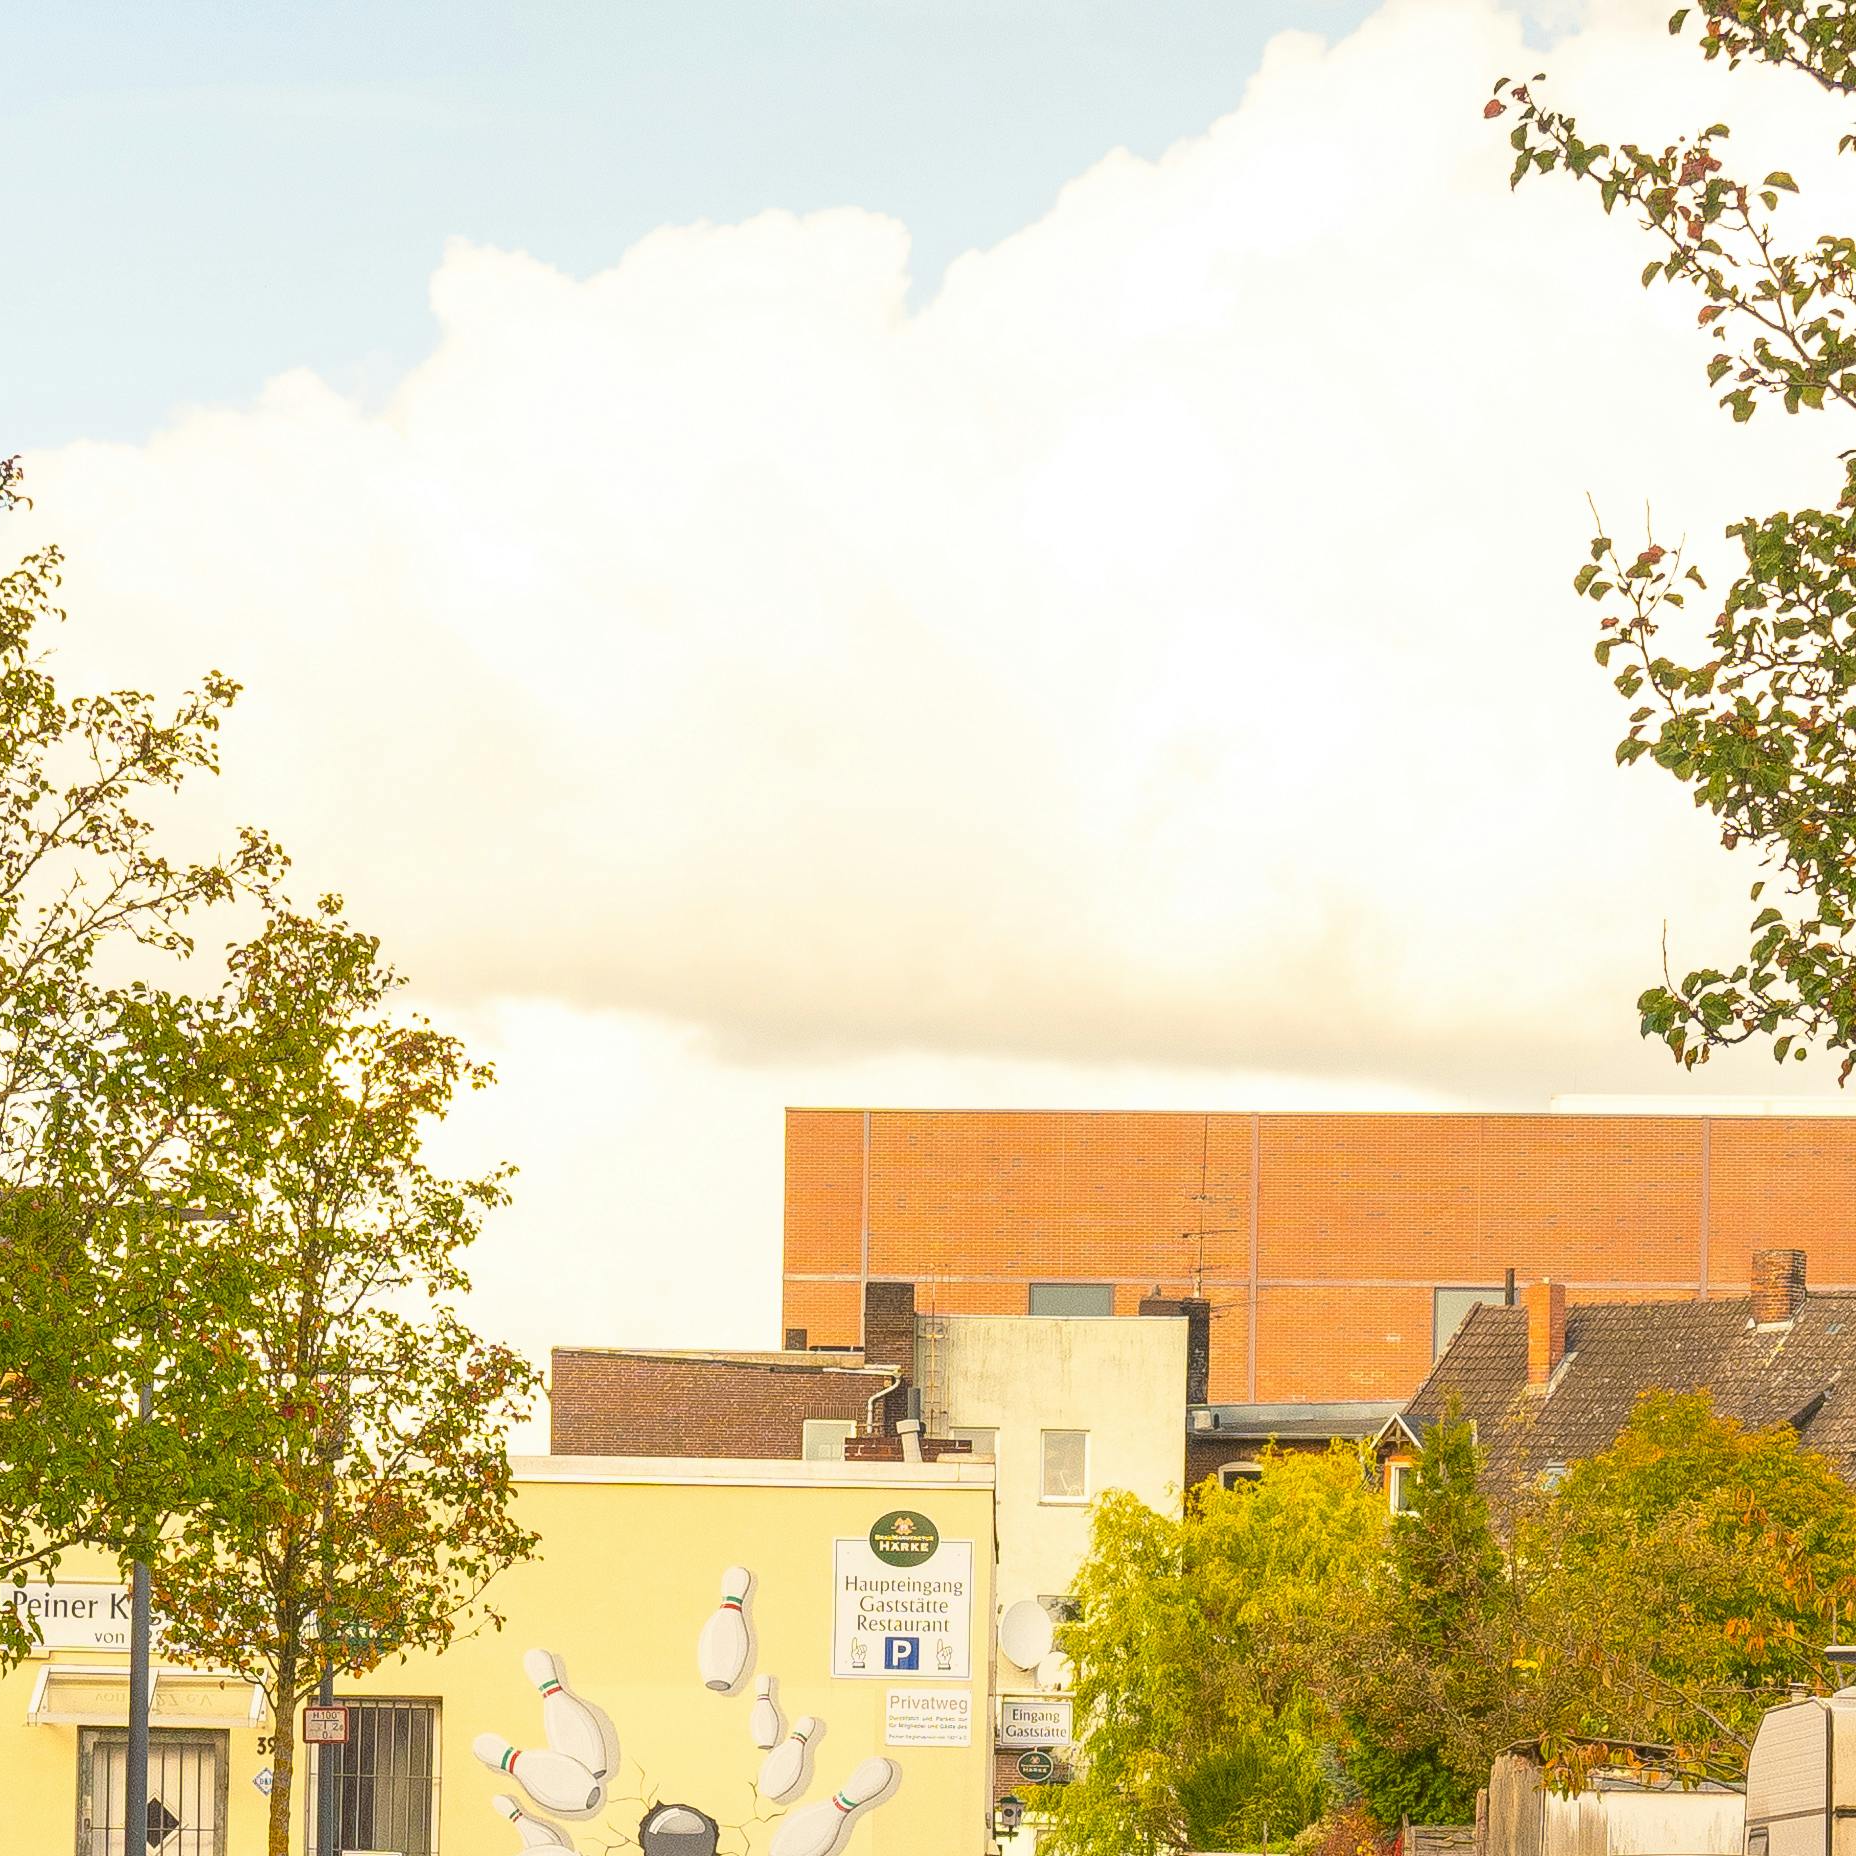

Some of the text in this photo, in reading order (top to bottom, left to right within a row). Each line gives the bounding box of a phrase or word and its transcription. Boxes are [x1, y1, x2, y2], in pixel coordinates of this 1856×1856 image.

[879, 1540, 929, 1552] HÄRKE
[845, 1575, 963, 1597] Haupteingang
[12, 1590, 99, 1619] Peiner
[859, 1595, 949, 1613] Gaststätte
[857, 1614, 950, 1632] Restaurant
[93, 1632, 125, 1644] von
[892, 1639, 912, 1666] P
[889, 1695, 968, 1714] Privatweg
[1012, 1708, 1060, 1724] Eingang
[1005, 1724, 1067, 1738] Gaststätte
[256, 1736, 275, 1755] 39
